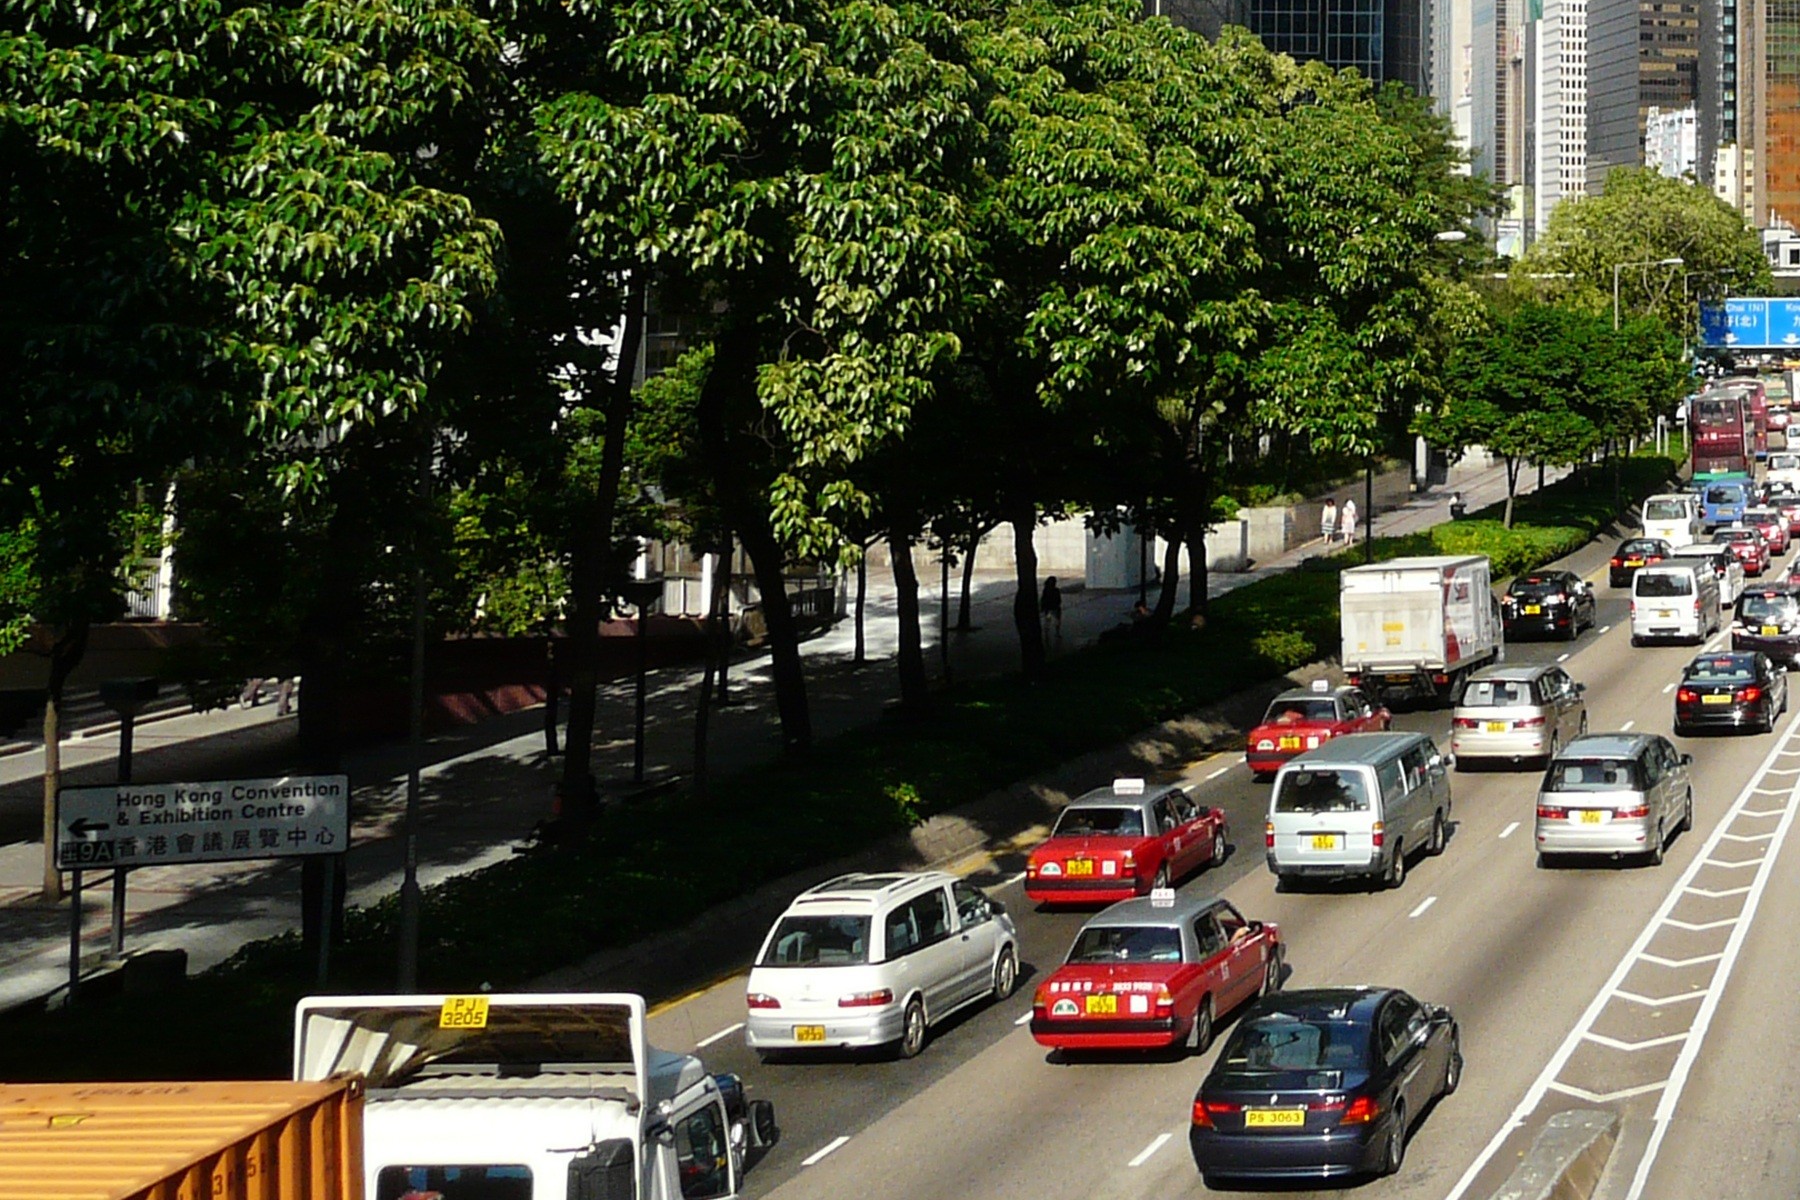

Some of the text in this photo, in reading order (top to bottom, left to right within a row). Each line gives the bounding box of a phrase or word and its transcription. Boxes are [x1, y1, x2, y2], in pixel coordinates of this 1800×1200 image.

[116, 782, 340, 809] Hong Kong Convention
[116, 803, 306, 827] & Exhibition Centre
[116, 826, 336, 858] 香港會議展覽中心
[454, 998, 477, 1012] PJ
[443, 1011, 484, 1026] 3205
[1249, 1112, 1301, 1123] PS 3063
